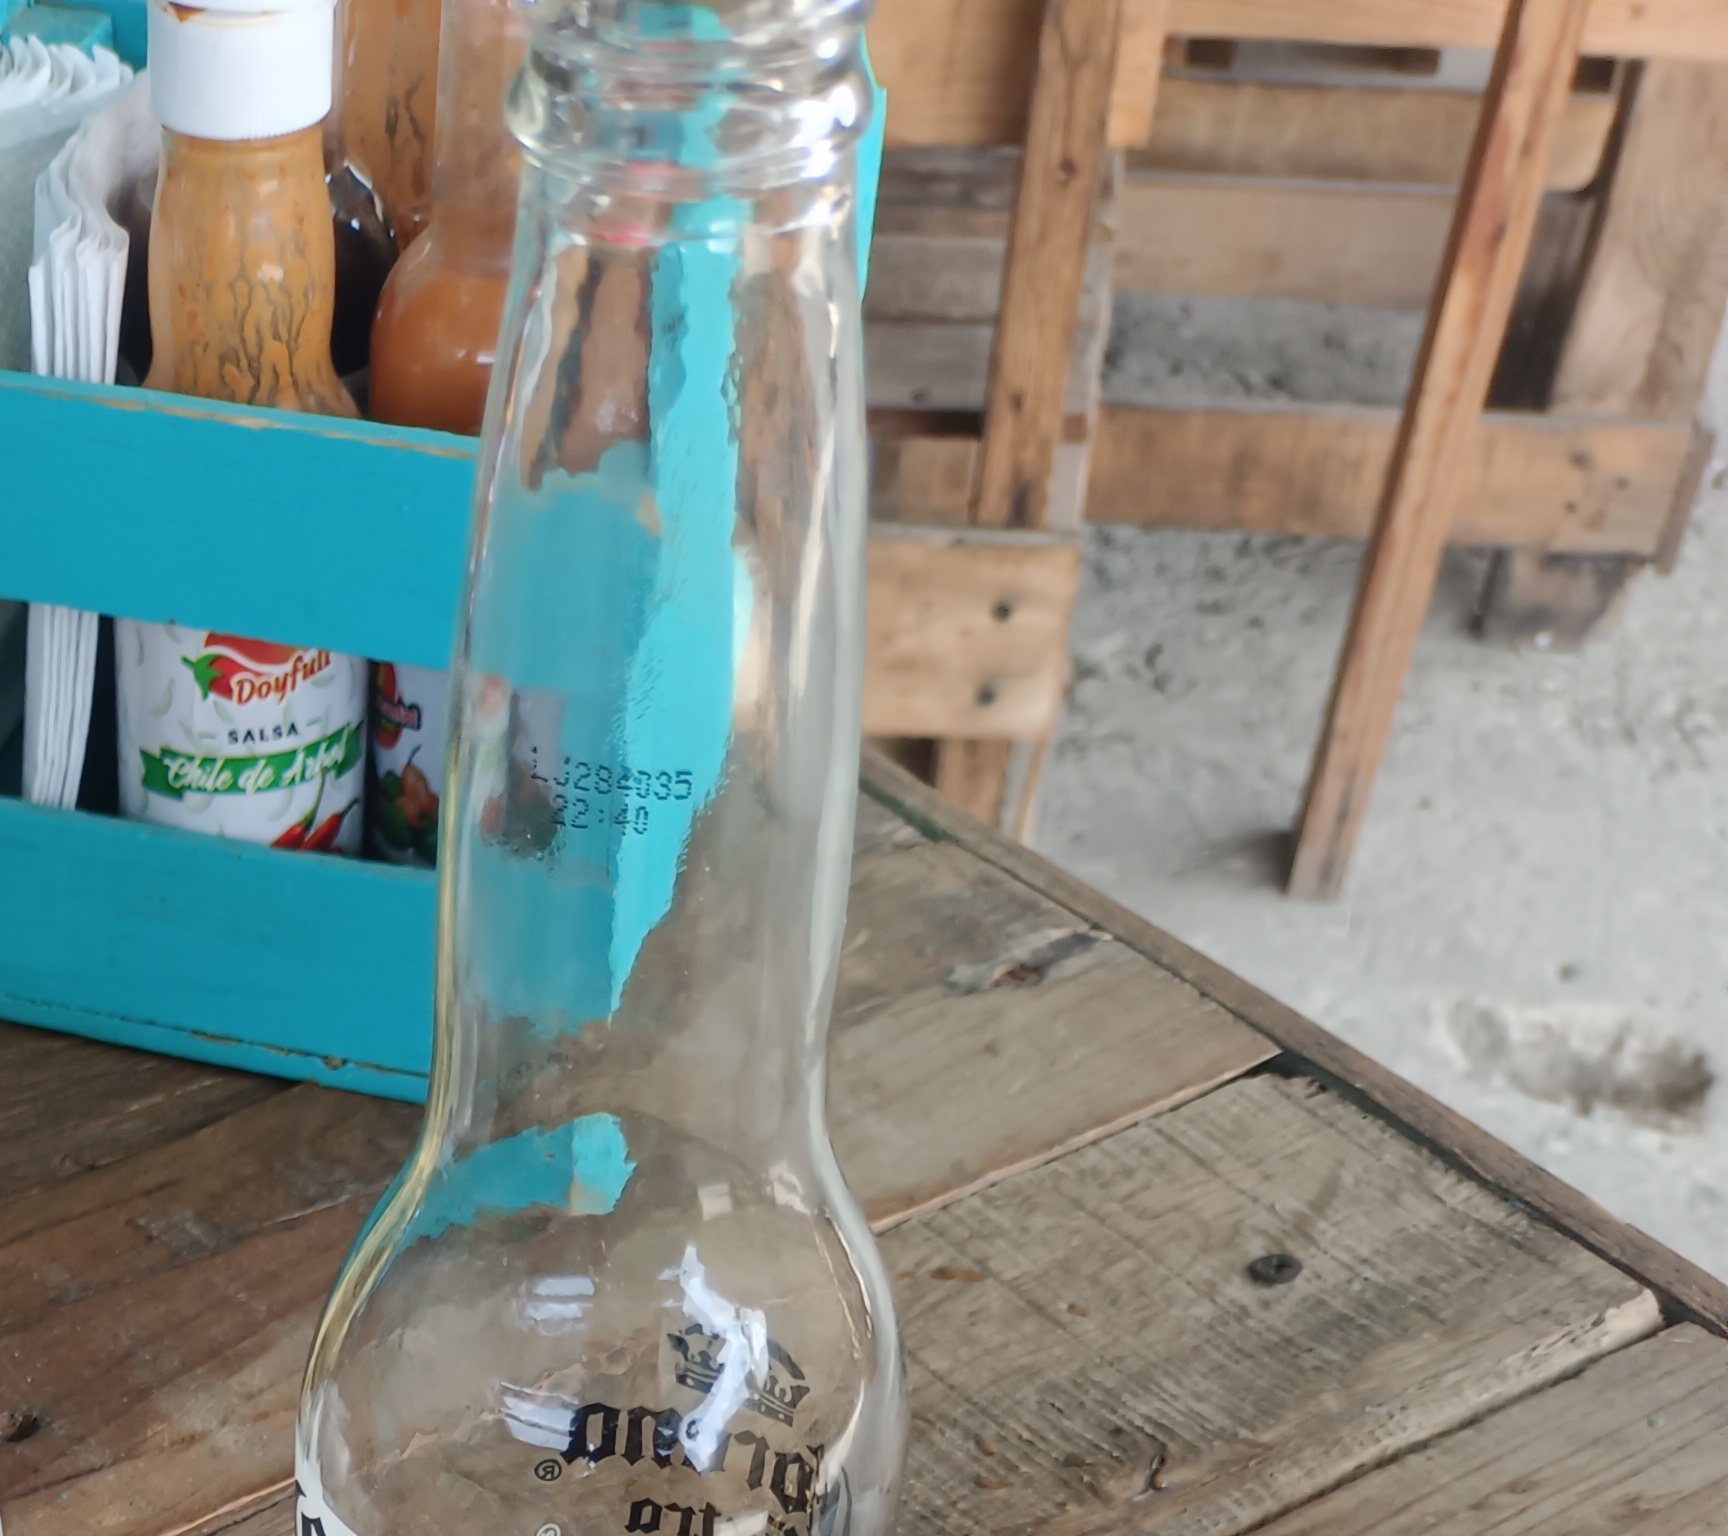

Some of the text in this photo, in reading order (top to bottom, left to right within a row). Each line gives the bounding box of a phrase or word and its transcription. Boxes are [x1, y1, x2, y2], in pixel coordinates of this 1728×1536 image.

[228, 722, 299, 745] SALSA
[163, 754, 236, 792] Chile
[237, 756, 276, 796] de
